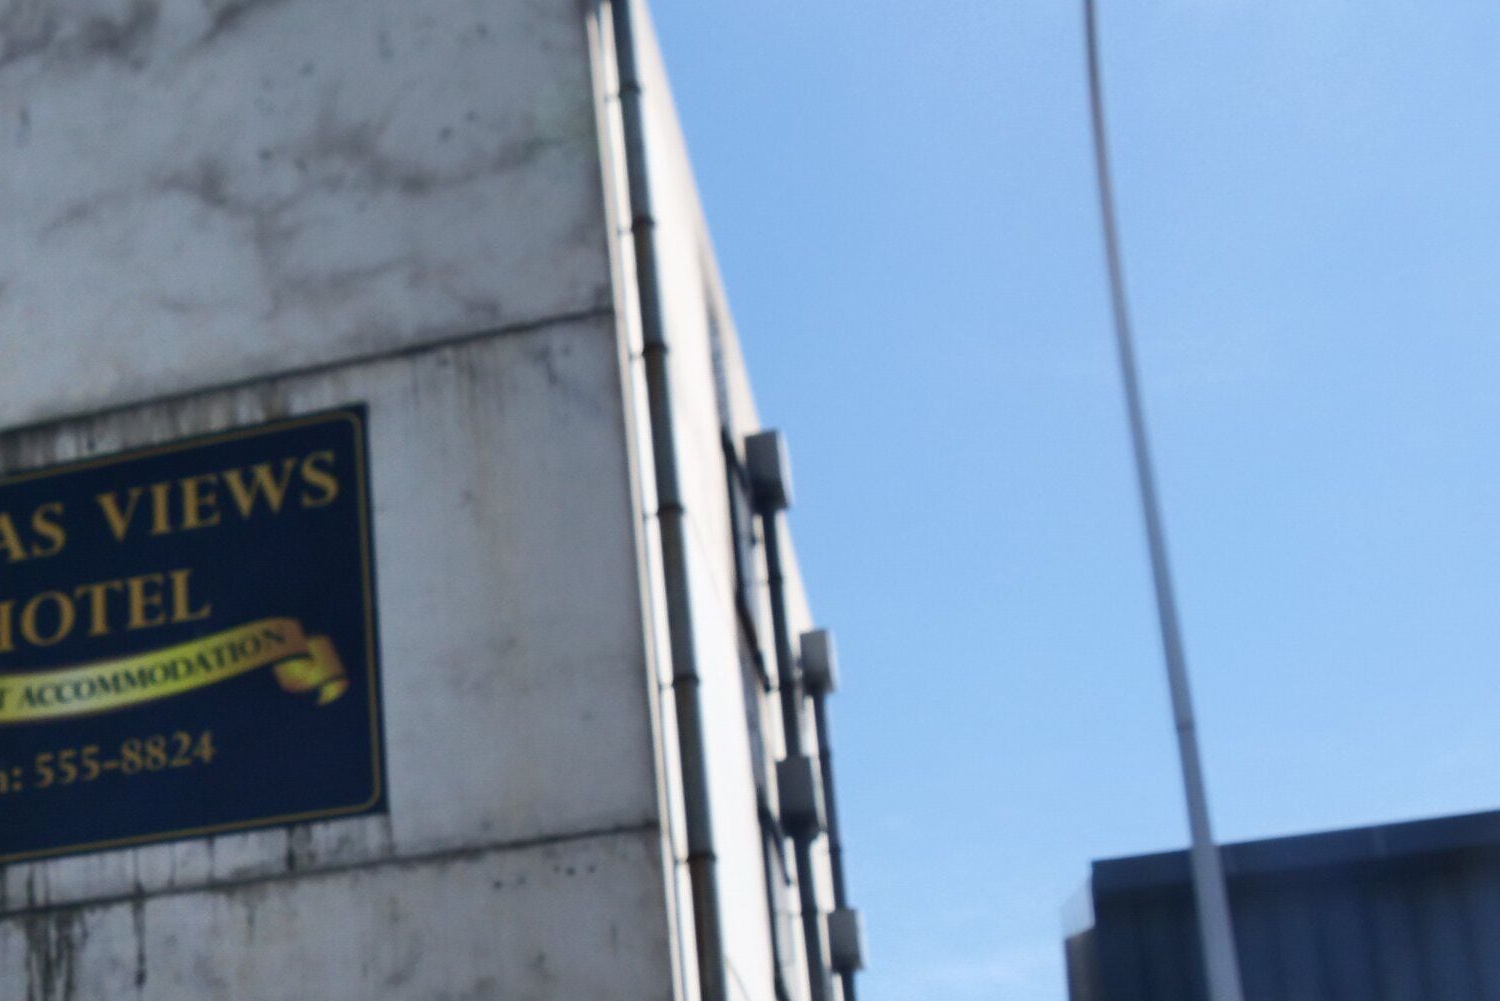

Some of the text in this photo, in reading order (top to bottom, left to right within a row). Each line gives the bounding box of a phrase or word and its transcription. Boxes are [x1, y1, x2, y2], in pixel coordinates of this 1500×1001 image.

[98, 451, 340, 541] VIEWS
[18, 627, 288, 710] ACCOMMODATION
[35, 730, 216, 788] 555-8824
